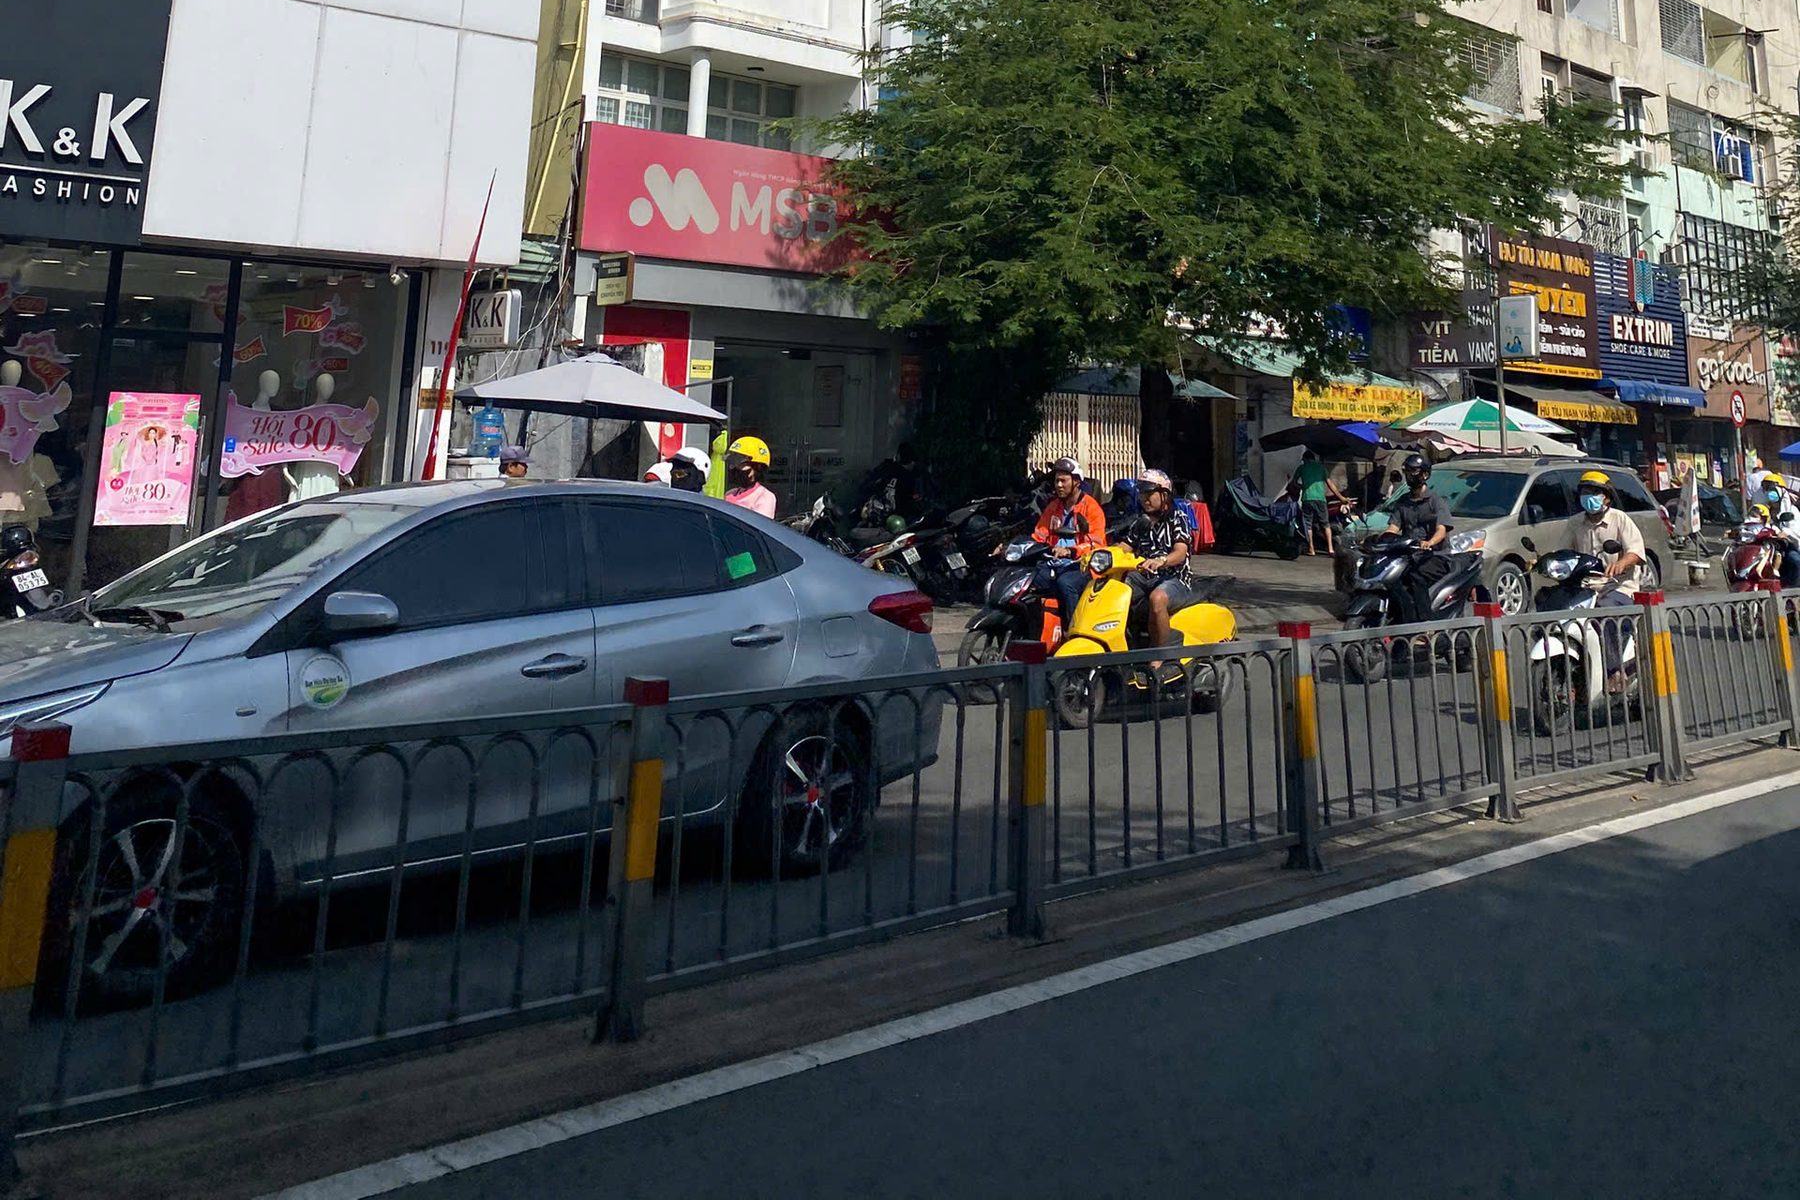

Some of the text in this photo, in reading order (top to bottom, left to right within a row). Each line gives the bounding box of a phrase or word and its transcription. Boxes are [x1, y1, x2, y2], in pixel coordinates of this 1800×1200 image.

[730, 181, 838, 241] MSB
[1535, 249, 1562, 272] NAM
[1562, 254, 1591, 277] VANG
[1508, 282, 1587, 318] UYÊN
[294, 314, 322, 328] 70%
[1421, 320, 1452, 338] VỊT
[1612, 314, 1674, 347] EXTRIM
[1418, 342, 1459, 363] TIỀM
[1468, 341, 1495, 363] VANG
[1610, 342, 1628, 354] SHOE
[1629, 344, 1647, 356] CARE
[1653, 347, 1671, 359] MORE
[289, 413, 337, 453] 80
[142, 483, 166, 501] 80
